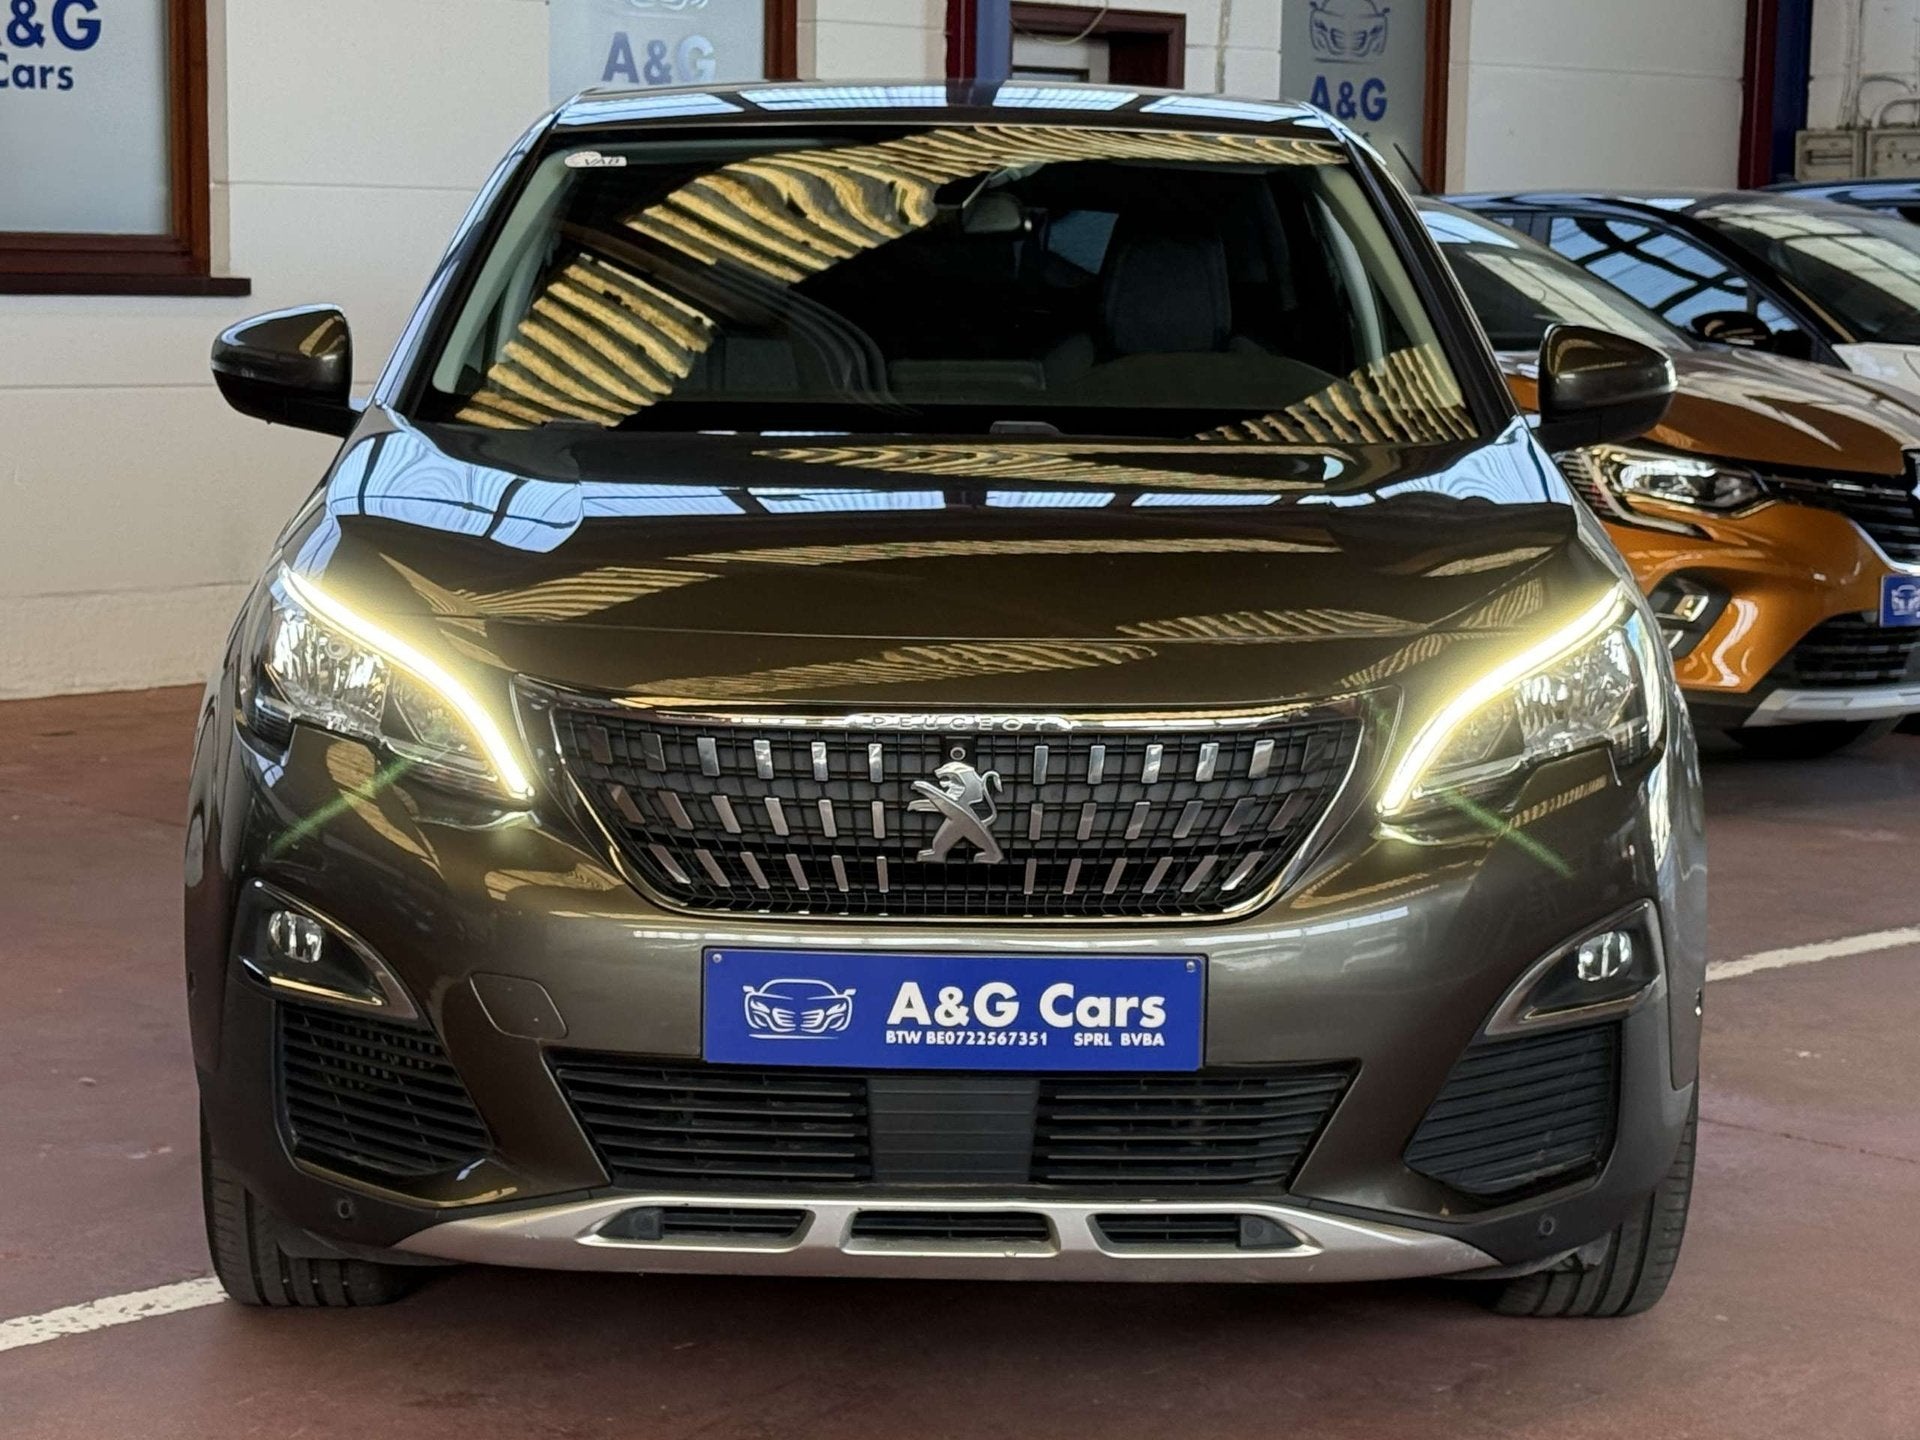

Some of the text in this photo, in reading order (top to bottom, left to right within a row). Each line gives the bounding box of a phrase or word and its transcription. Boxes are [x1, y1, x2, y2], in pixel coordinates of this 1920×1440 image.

[0, 0, 101, 51] &G
[602, 31, 716, 84] A&G
[1310, 75, 1388, 122] A&G
[872, 715, 1054, 731] PEUGEOT
[886, 981, 1166, 1028] A&G Cars
[886, 1030, 1165, 1047] BTW BE0722567351 SPRL BVBA
